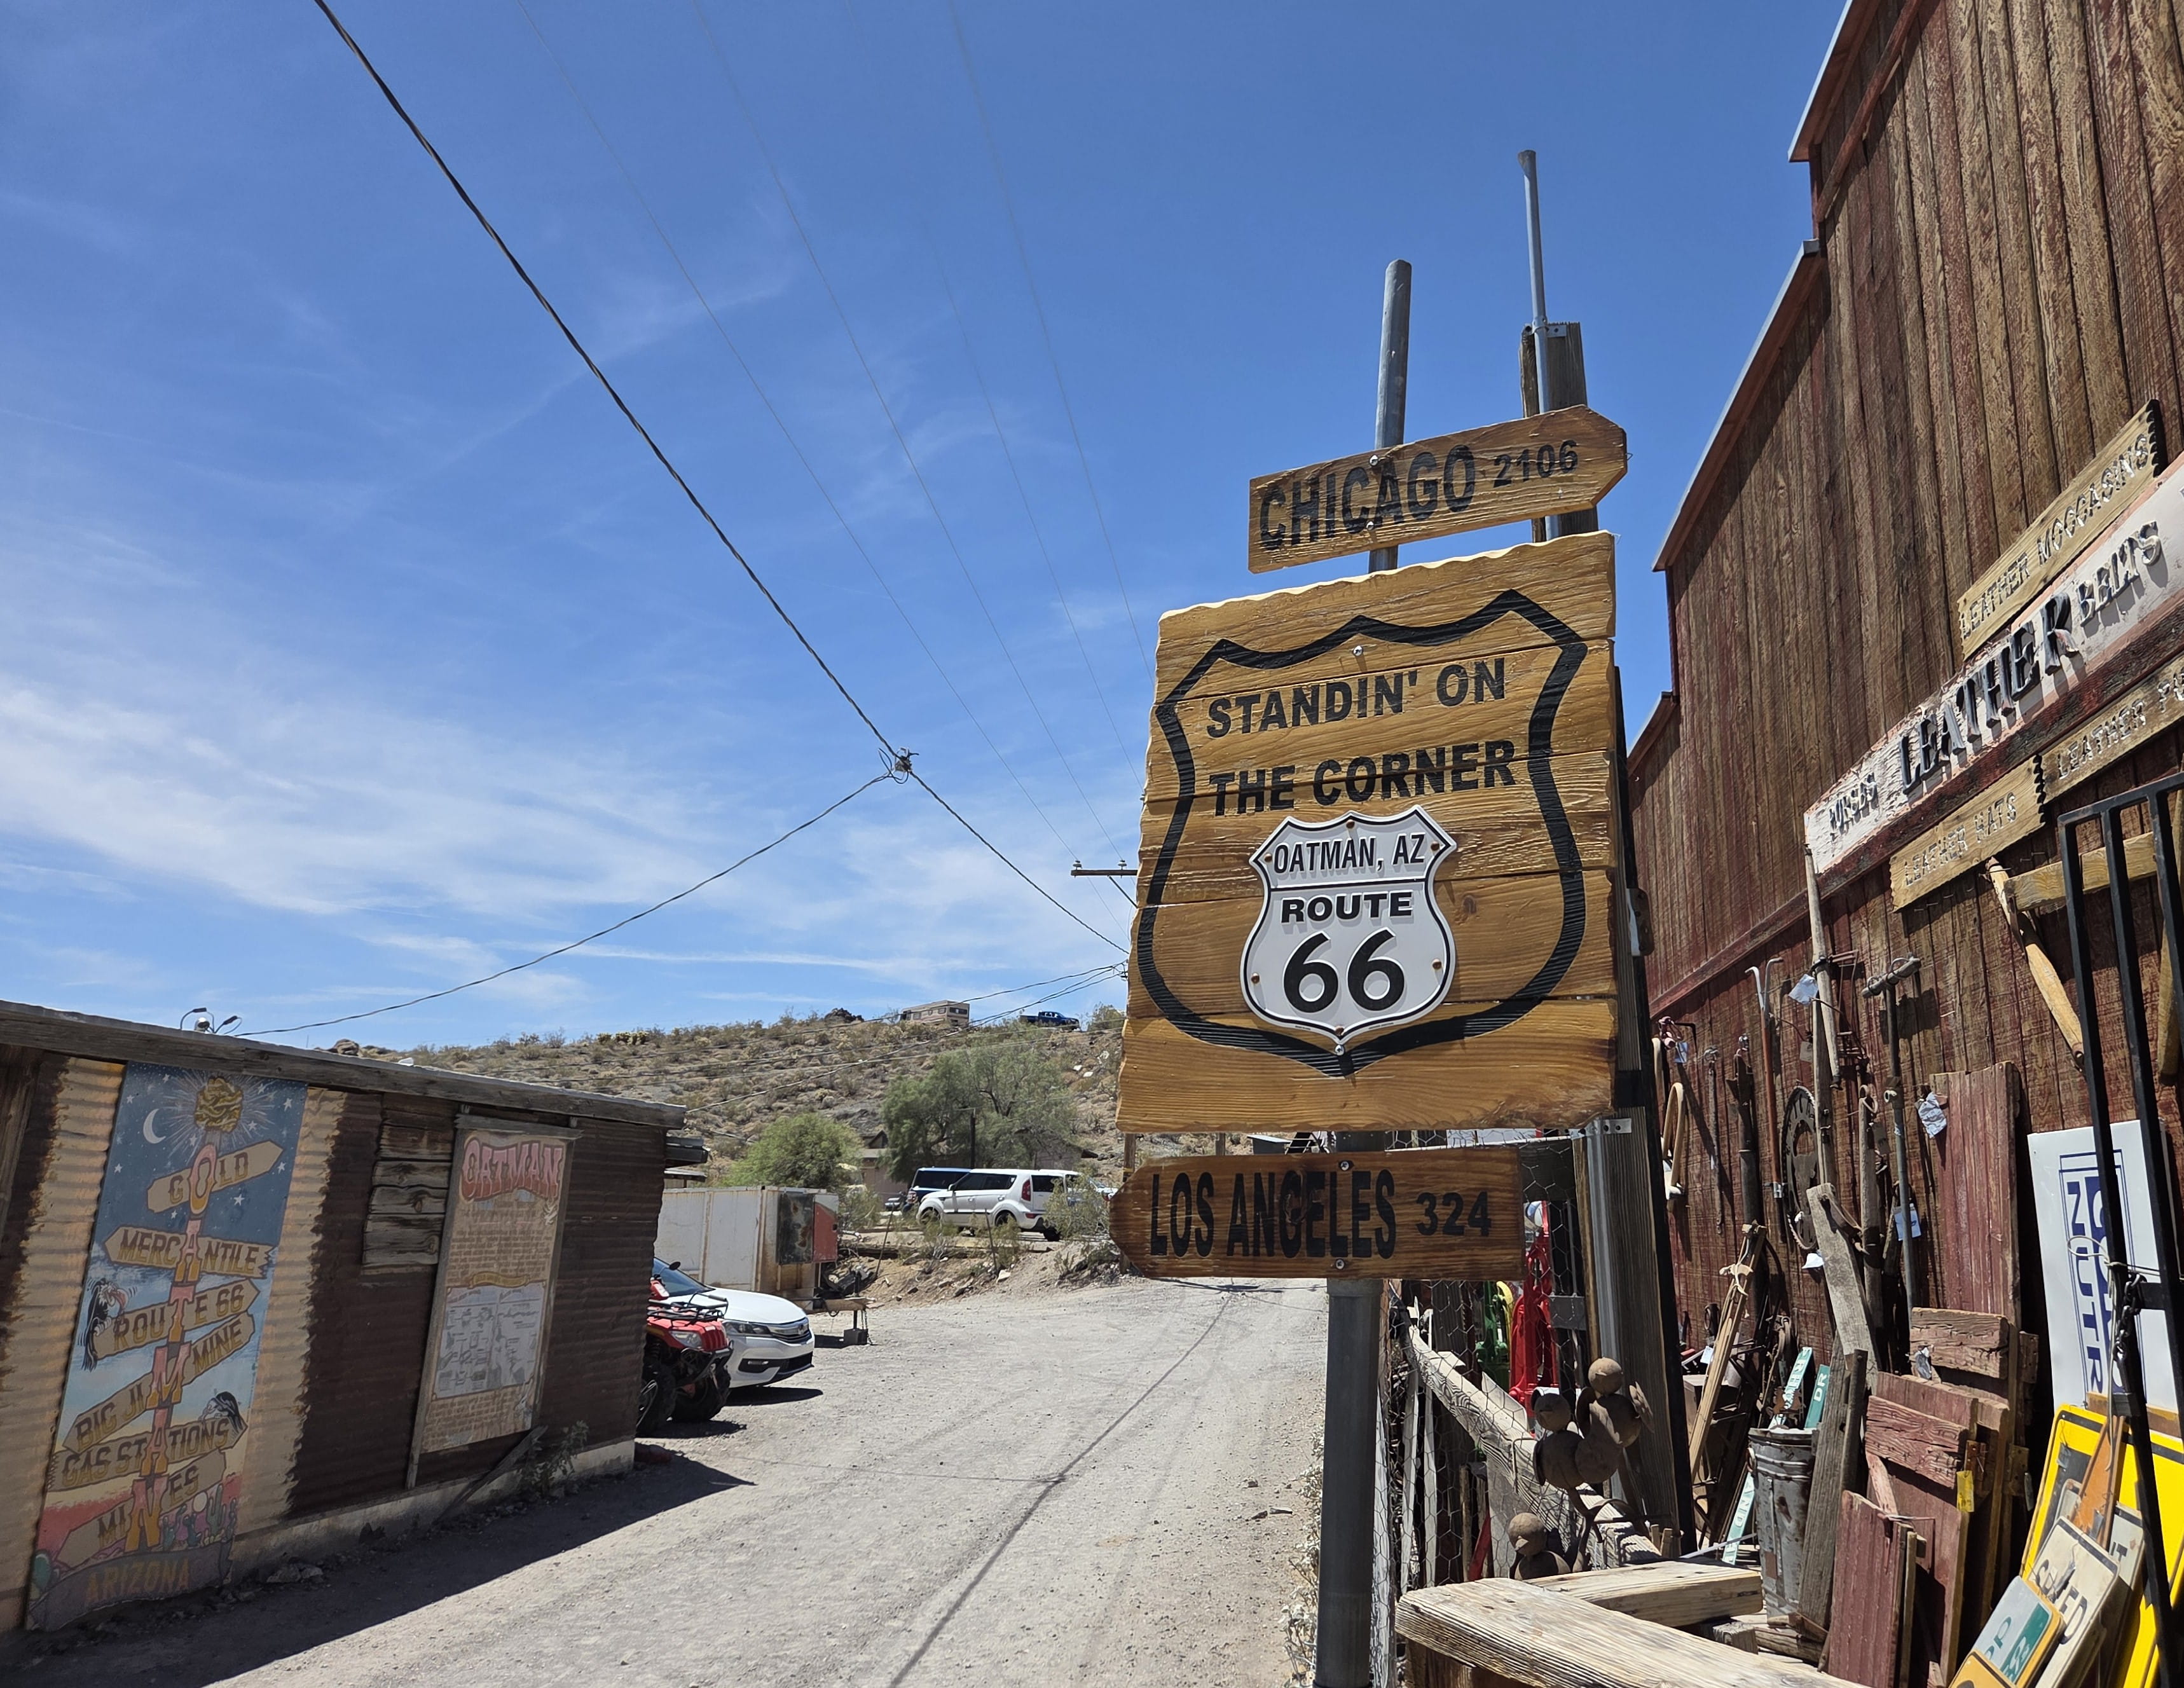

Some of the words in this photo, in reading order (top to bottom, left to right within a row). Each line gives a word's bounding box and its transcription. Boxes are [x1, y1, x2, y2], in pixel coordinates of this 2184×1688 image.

[1259, 445, 1476, 551] CHICAGO
[1494, 440, 1578, 488] 2106
[1959, 552, 2029, 640] LEATHER
[1899, 593, 2080, 795] LEATHER
[2076, 521, 2162, 627] BELTS
[1207, 670, 1417, 738] STANDIN'
[1437, 657, 1505, 707] ON
[1209, 765, 1295, 816] THE
[1313, 739, 1517, 806] CORNER
[2057, 699, 2146, 779] LEATHER
[1274, 837, 1384, 874] OATMAN,
[1392, 833, 1425, 865] AZ
[1904, 825, 1968, 886] LEATHER
[1974, 792, 2017, 843] HATS
[1281, 891, 1413, 923] ROUTE
[1283, 929, 1404, 1013] 66
[167, 1144, 249, 1214] GOLD
[462, 1140, 563, 1201] OATMAN
[118, 1224, 260, 1278] MERCANTILE
[1150, 1172, 1214, 1258] LOS
[1227, 1169, 1396, 1259] ANGELES
[1415, 1192, 1492, 1237] 324
[113, 1286, 208, 1351] ROUTE
[216, 1284, 245, 1317] 66
[74, 1401, 117, 1451] BIG
[192, 1319, 245, 1372] MINE
[1814, 1372, 1829, 1403] DR
[62, 1445, 111, 1487] GAS
[116, 1418, 230, 1476] STATIONS
[99, 1465, 199, 1552] MINES
[85, 1557, 190, 1603] ARIZONA
